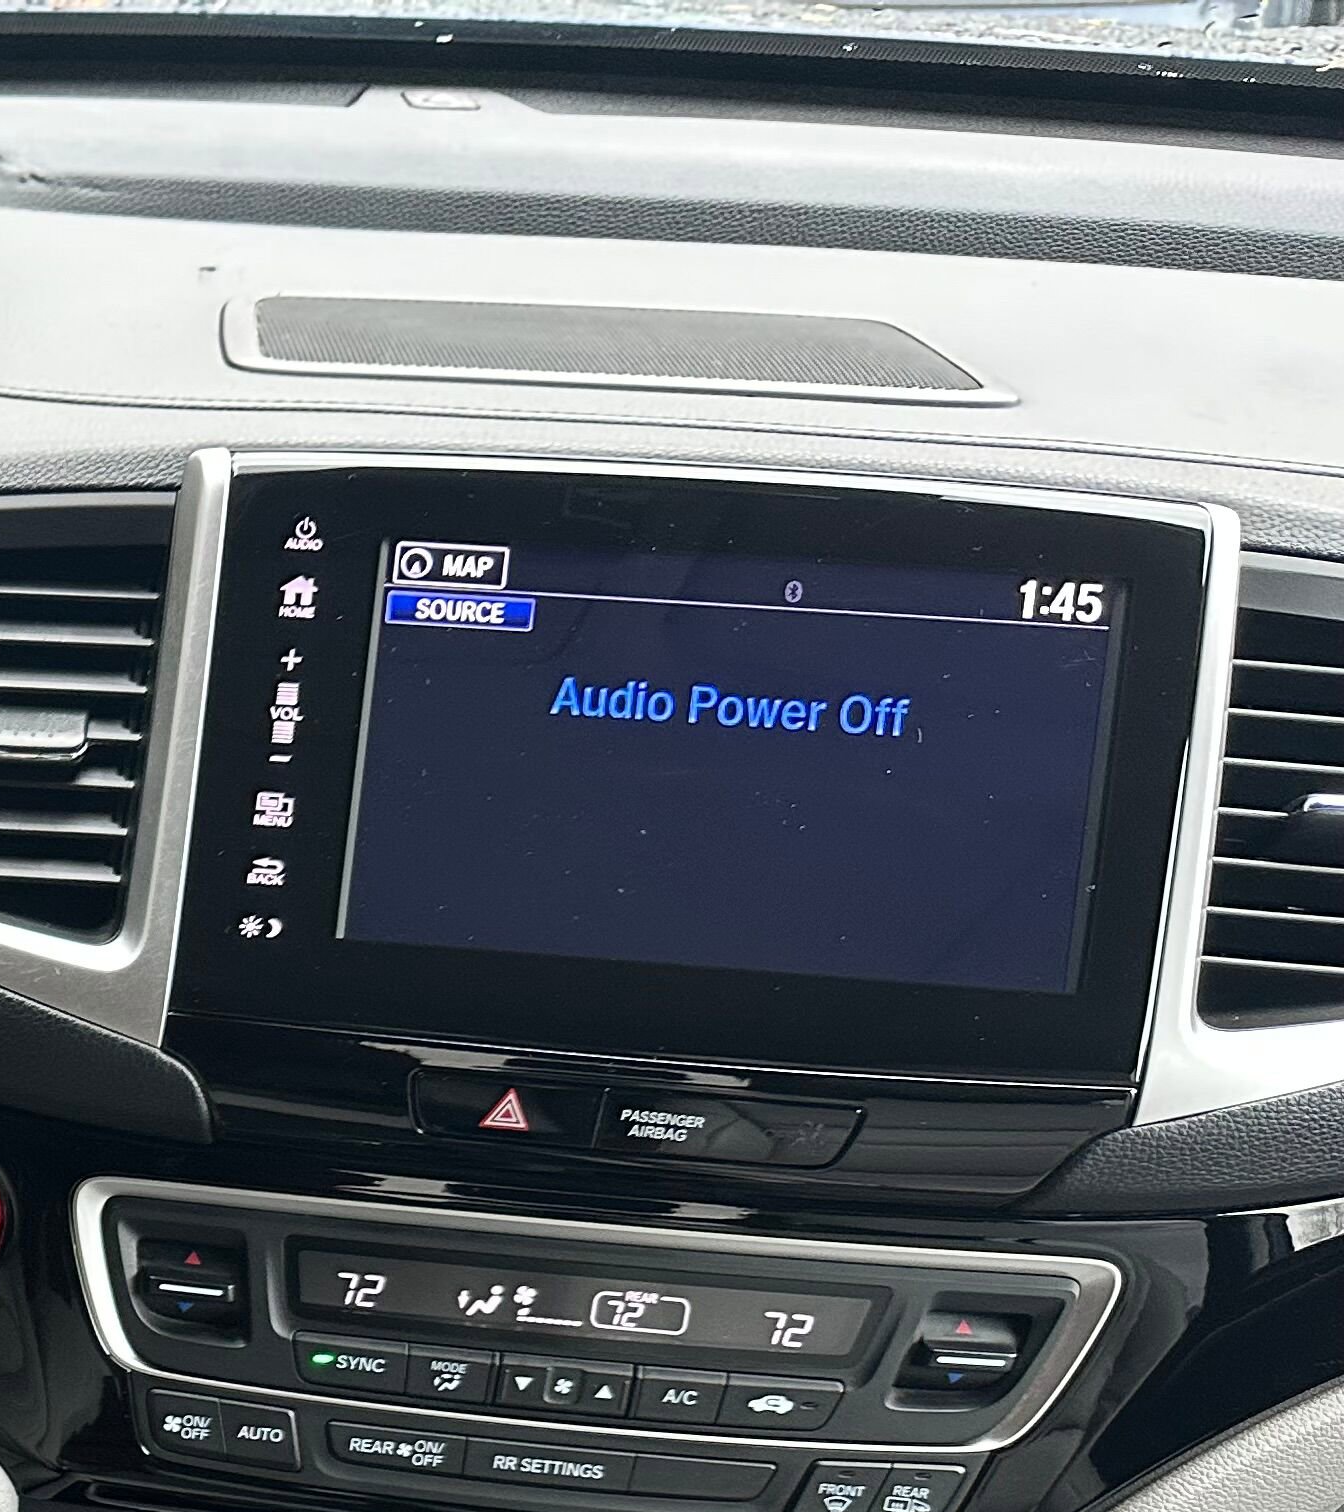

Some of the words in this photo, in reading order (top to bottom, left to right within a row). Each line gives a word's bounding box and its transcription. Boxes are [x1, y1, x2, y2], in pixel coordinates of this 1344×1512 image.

[284, 537, 324, 551] AUDIO
[441, 554, 494, 579] MAP
[1019, 579, 1105, 623] 1:45
[278, 605, 316, 619] HOME
[415, 598, 505, 625] SOURCE
[270, 706, 303, 721] VOL
[550, 675, 674, 724] Audio
[687, 683, 828, 733] Power
[838, 693, 910, 738] Off
[253, 814, 293, 828] MENU
[246, 872, 285, 886] BACK
[620, 1108, 705, 1130] PASSENGER
[628, 1126, 688, 1143] AIRBAG
[336, 1271, 387, 1308] 72
[607, 1300, 645, 1327] 72
[764, 1310, 815, 1349] 72
[336, 1353, 386, 1374] SYNC
[430, 1359, 468, 1375] MODE
[661, 1389, 698, 1406] A/C
[180, 1425, 210, 1440] OFF
[236, 1425, 284, 1444] AUTO
[348, 1437, 394, 1456] REAR
[411, 1452, 444, 1469] OFF
[492, 1454, 516, 1471] RR
[520, 1457, 604, 1480] SETTINGS
[817, 1483, 866, 1498] FRONT
[892, 1485, 930, 1500] REAR
